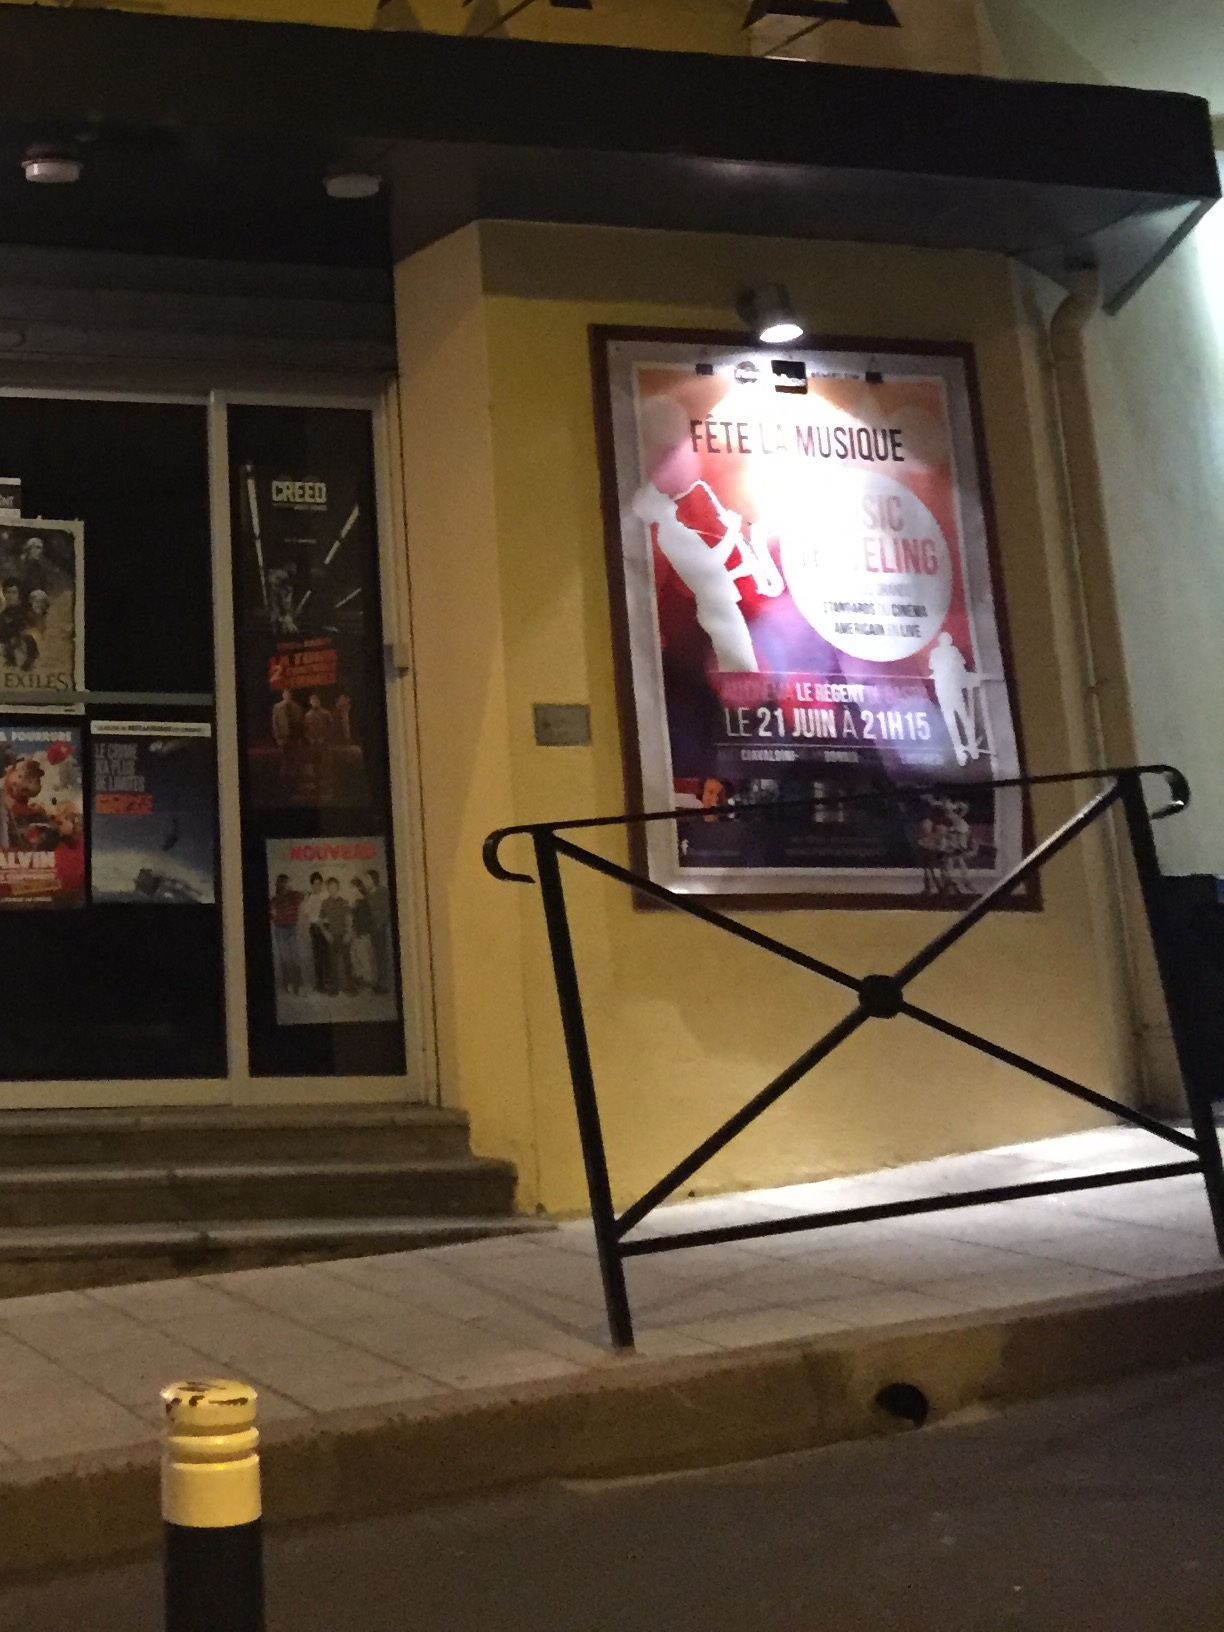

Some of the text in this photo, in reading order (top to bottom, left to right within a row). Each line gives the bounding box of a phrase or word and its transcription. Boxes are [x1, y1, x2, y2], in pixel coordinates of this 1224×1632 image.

[689, 414, 753, 455] FÊTE
[795, 424, 905, 462] MUSIQUE
[271, 480, 327, 503] CREED
[795, 682, 814, 702] LE
[815, 683, 866, 704] REGENT
[725, 704, 931, 741] LE 21 JUIN À 21H15
[288, 842, 377, 862] NOUVEAU
